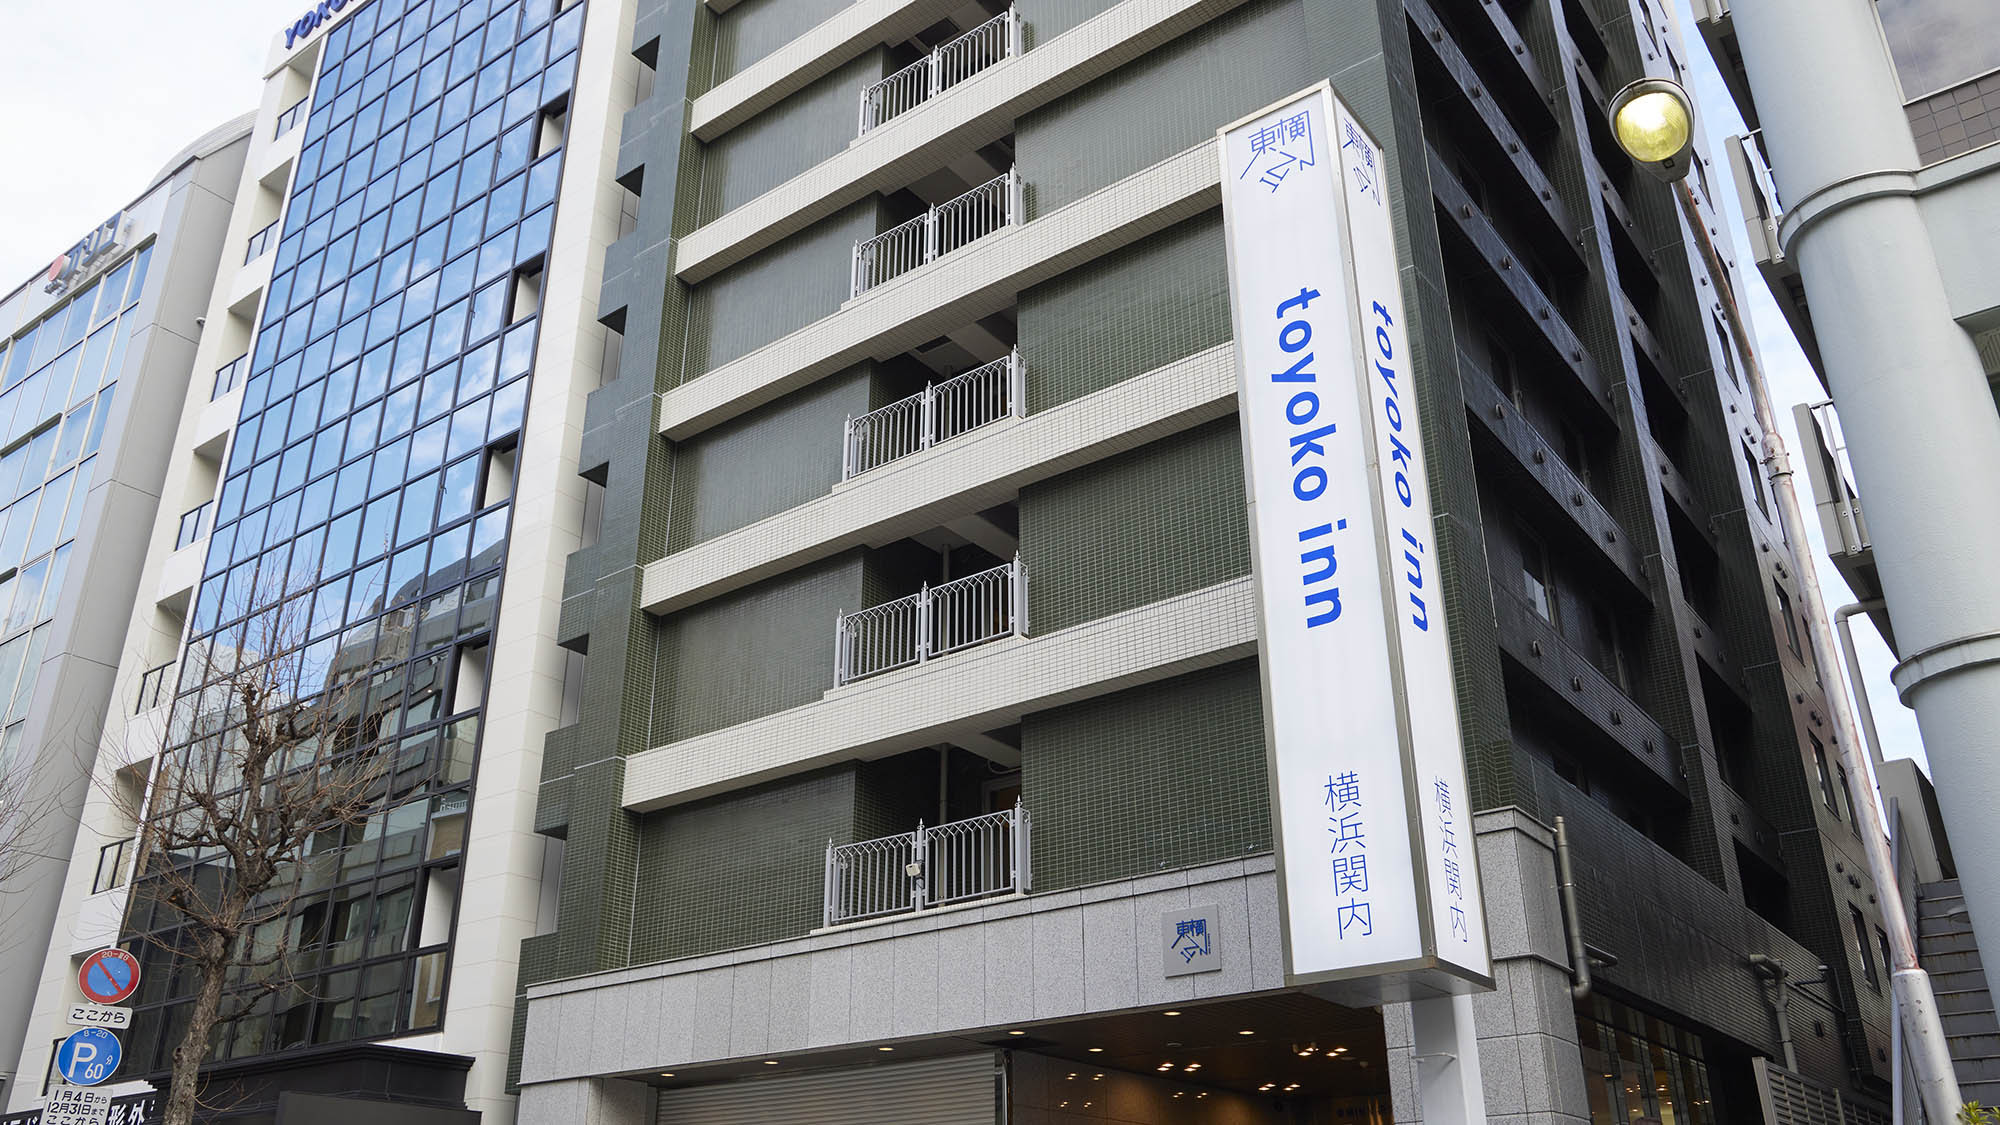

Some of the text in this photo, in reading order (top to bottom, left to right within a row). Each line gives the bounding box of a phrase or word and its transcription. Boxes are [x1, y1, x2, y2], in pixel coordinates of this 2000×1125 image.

[1271, 287, 1347, 629] toyoko inn
[1373, 300, 1429, 632] toyoko inn
[1324, 770, 1373, 940] 横浜関内
[1434, 775, 1467, 943] 横浜関内
[68, 1042, 97, 1078] P
[72, 1008, 126, 1024] ここから
